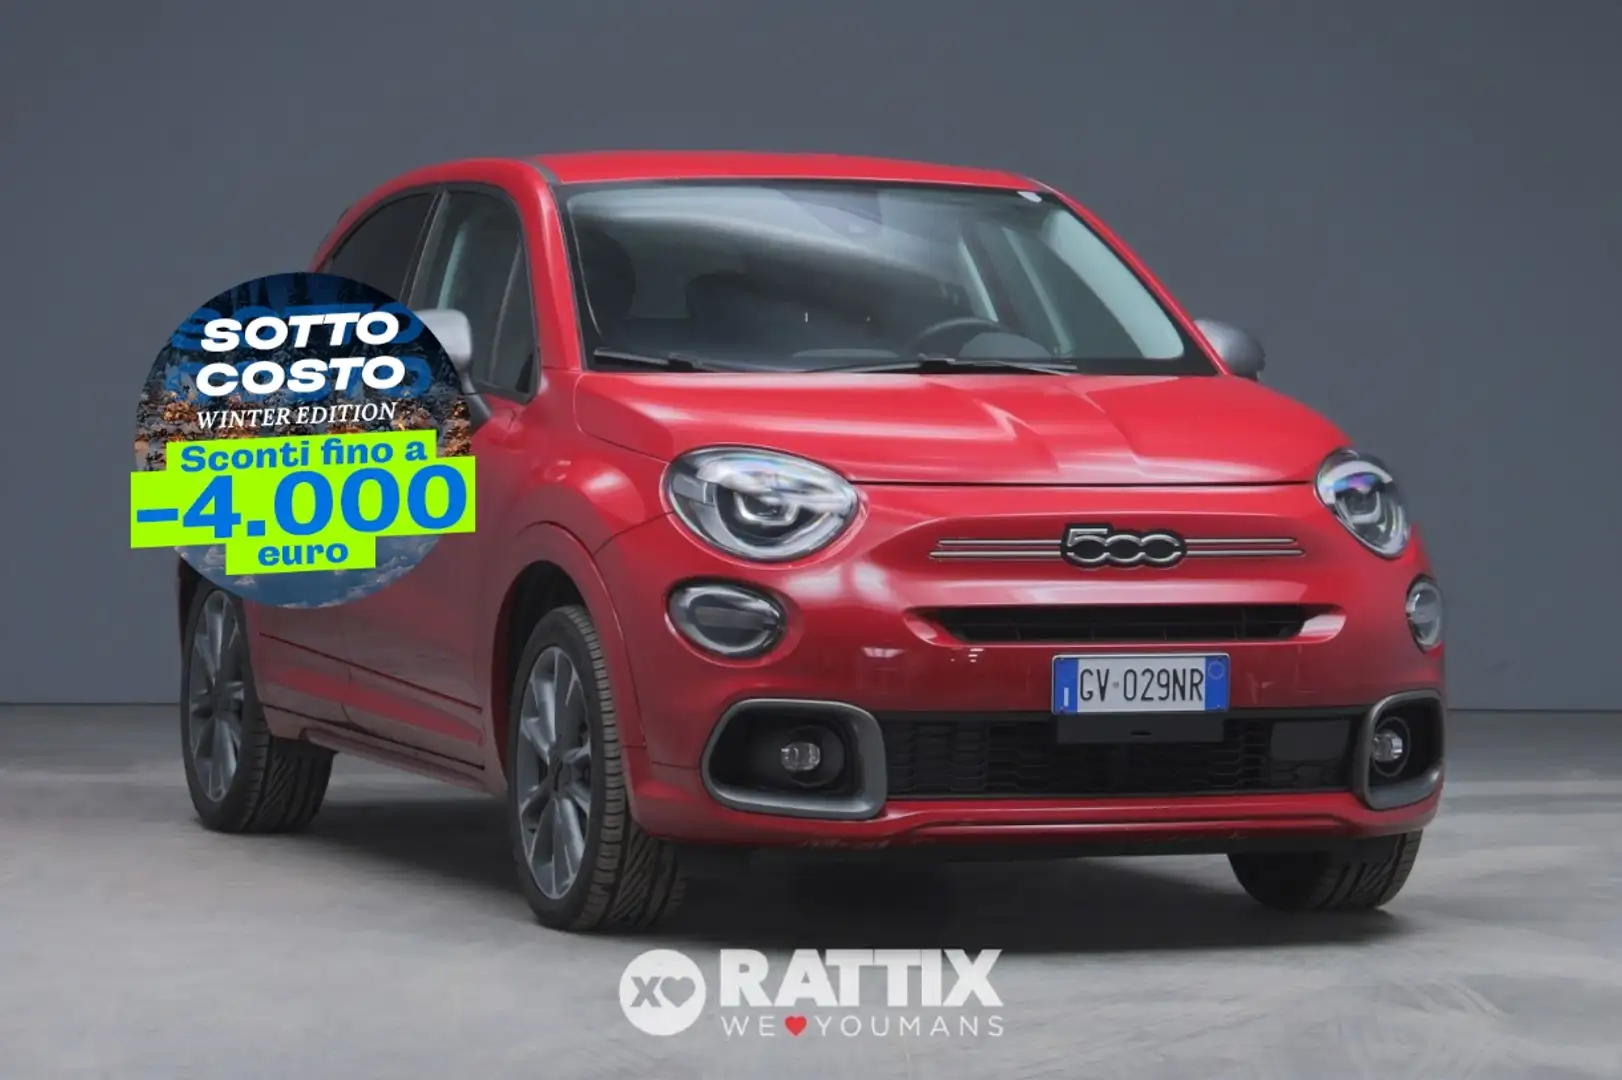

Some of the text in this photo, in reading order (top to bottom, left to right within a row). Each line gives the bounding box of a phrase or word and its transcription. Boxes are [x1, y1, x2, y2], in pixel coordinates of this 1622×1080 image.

[1066, 527, 1182, 563] 500
[1079, 668, 1109, 702] GV
[1123, 668, 1204, 702] 029NR
